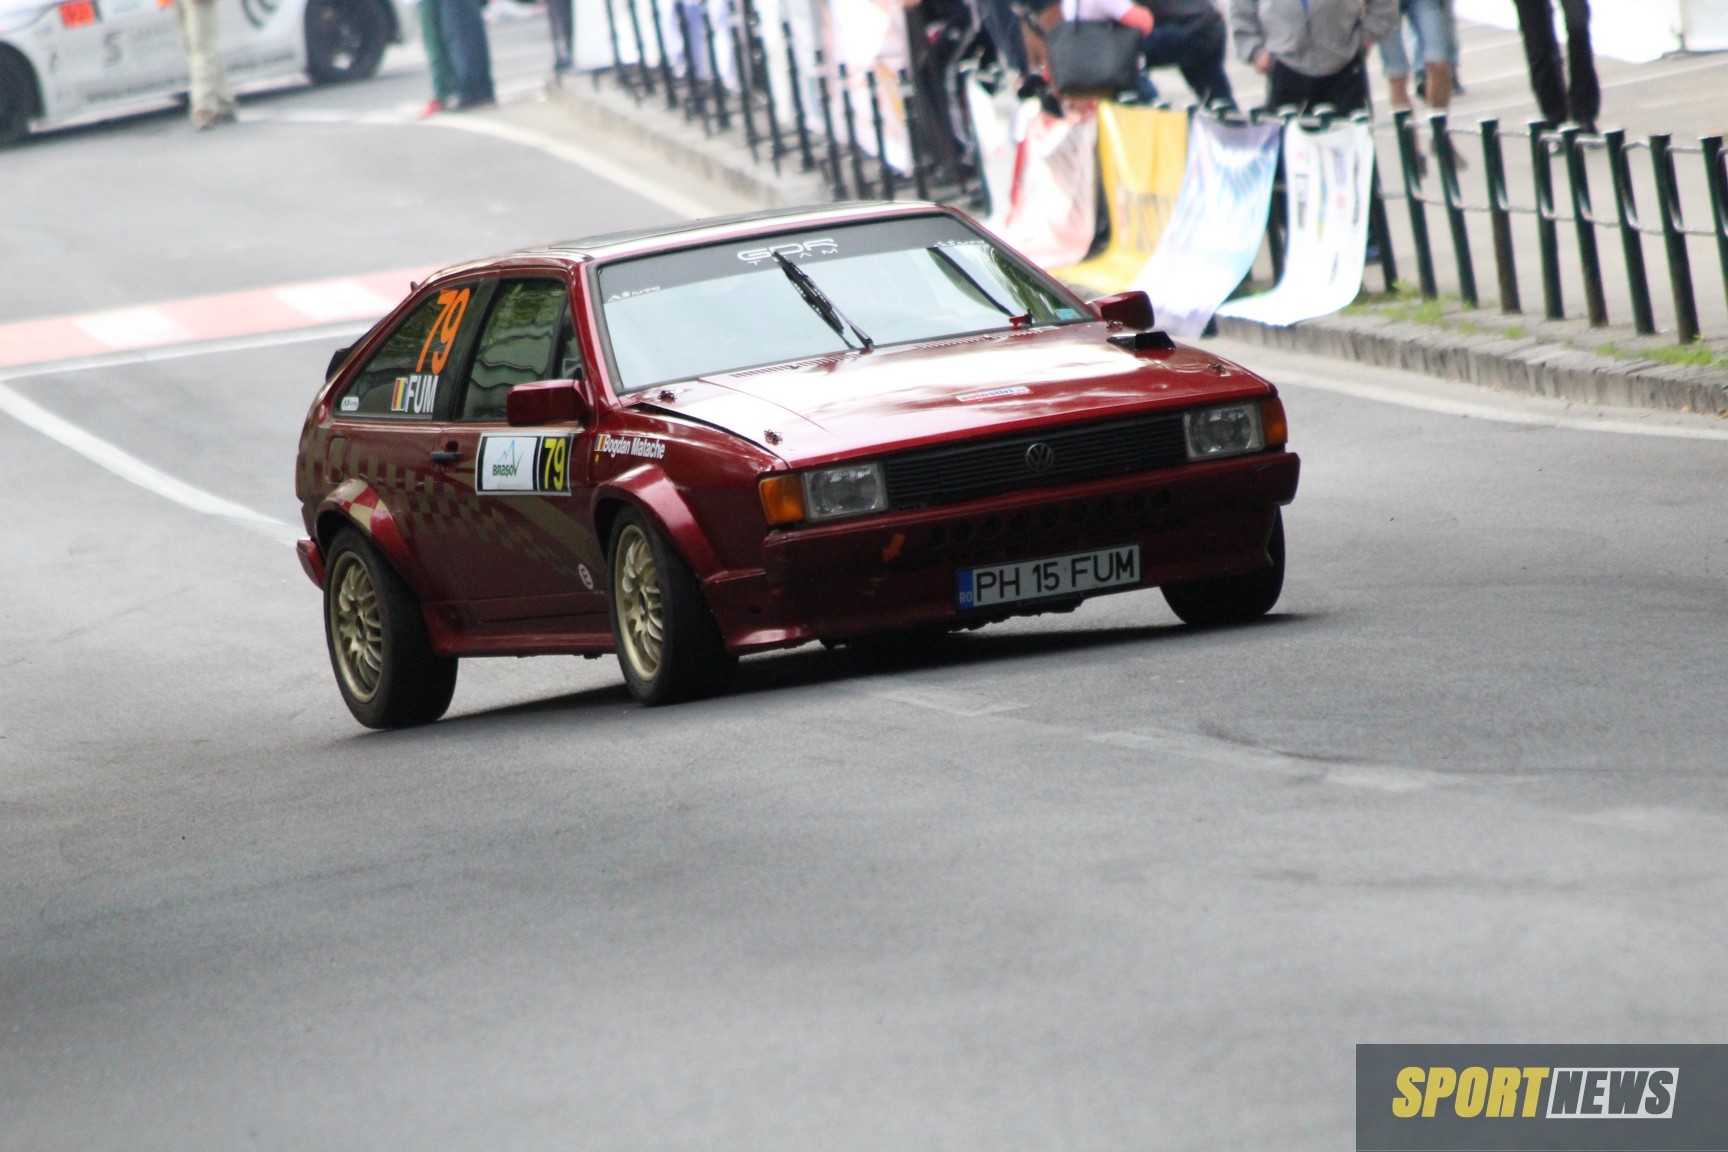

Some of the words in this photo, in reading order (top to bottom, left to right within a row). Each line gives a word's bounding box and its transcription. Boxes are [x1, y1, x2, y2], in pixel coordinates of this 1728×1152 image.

[748, 248, 838, 266] TAM
[415, 287, 471, 375] 79
[404, 374, 439, 413] FUM
[544, 437, 567, 491] 79
[602, 434, 631, 459] Bogdan
[633, 437, 666, 460] Matache
[959, 591, 973, 604] RO
[976, 567, 1020, 602] PH
[1032, 561, 1060, 593] 15
[1071, 549, 1135, 588] FUM
